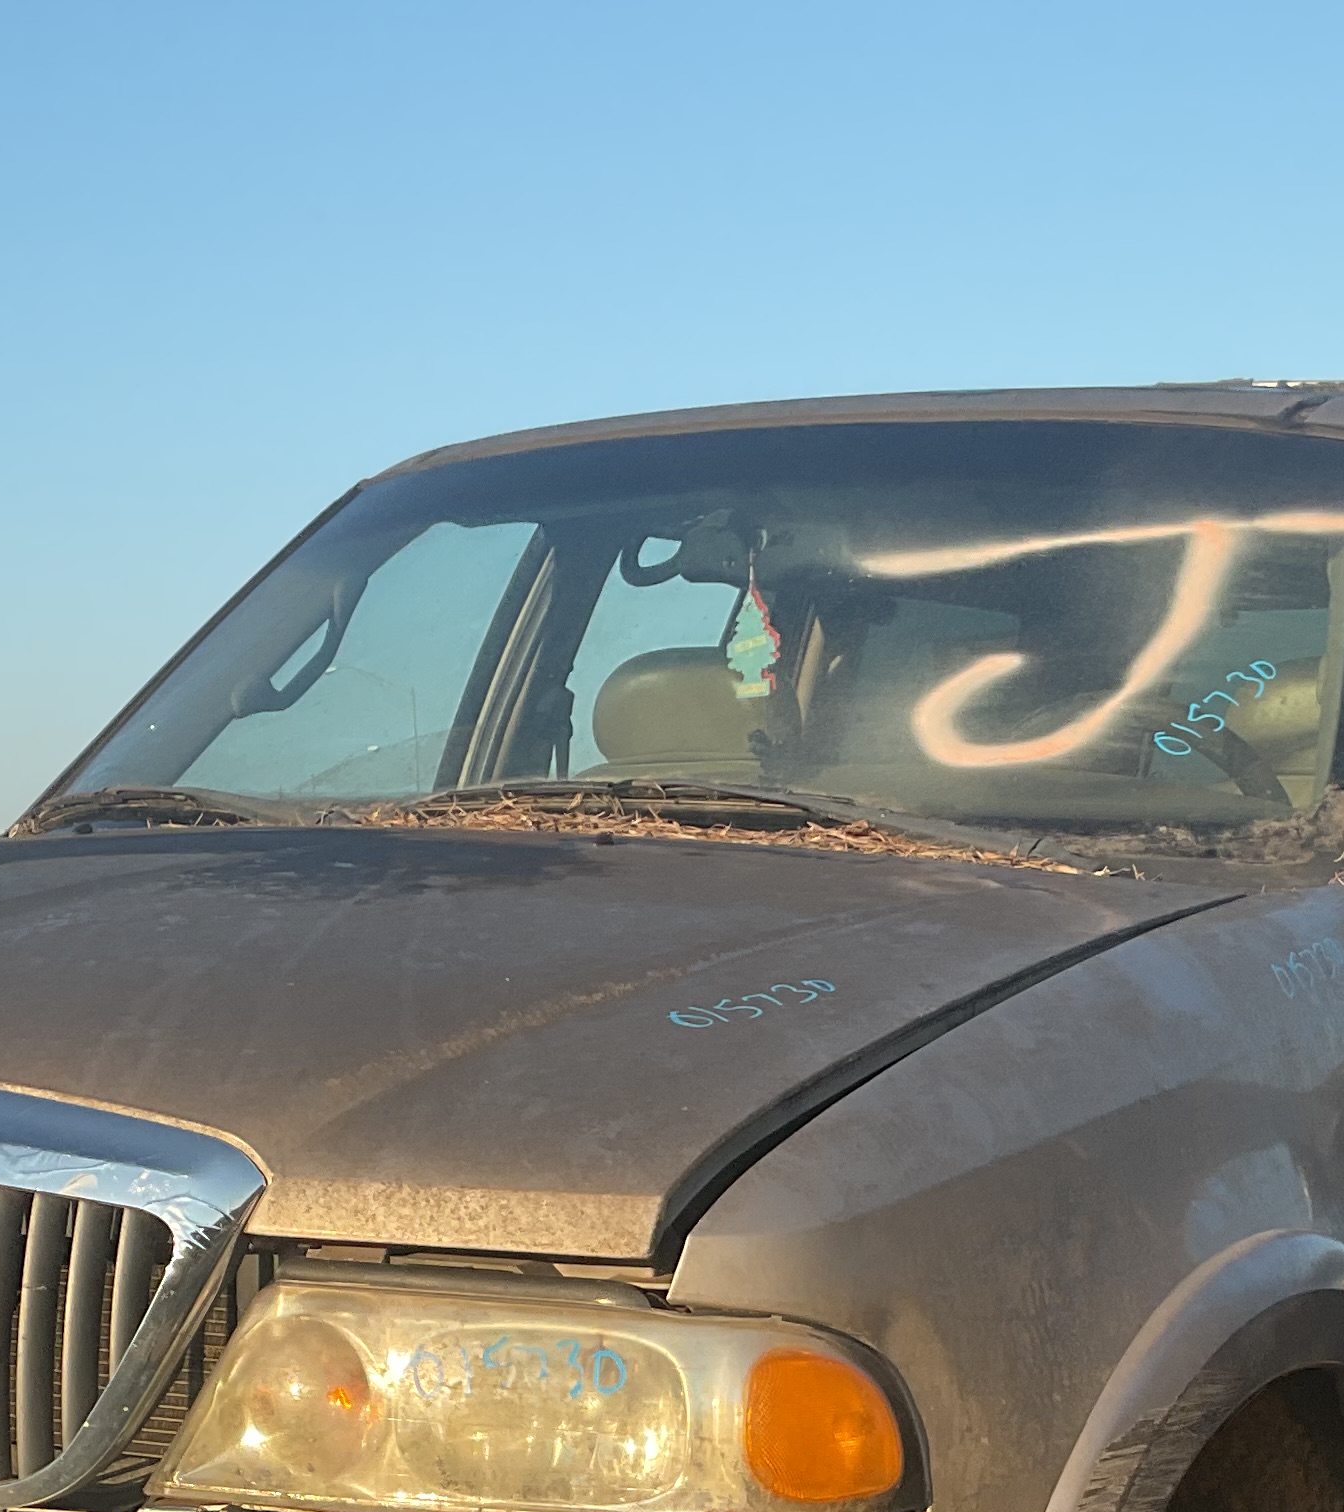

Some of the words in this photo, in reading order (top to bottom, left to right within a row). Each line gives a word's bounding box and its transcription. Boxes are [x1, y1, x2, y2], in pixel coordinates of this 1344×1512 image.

[1153, 660, 1277, 756] 015730
[666, 979, 836, 1028] 015730
[410, 1335, 627, 1399] 015730
